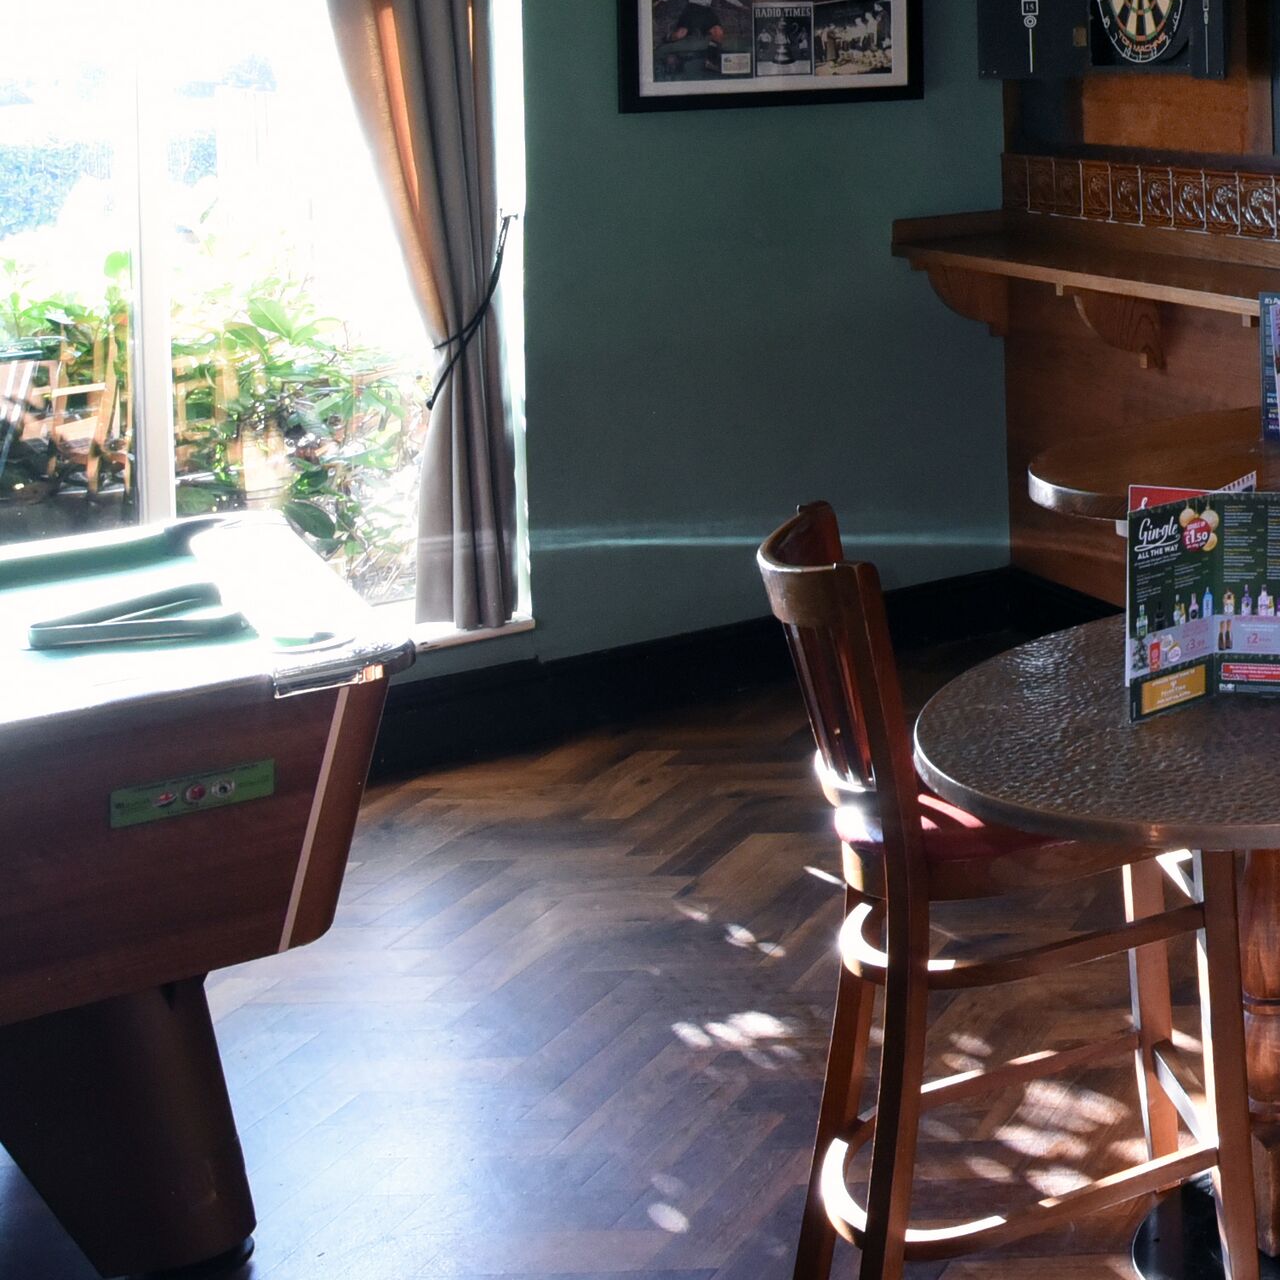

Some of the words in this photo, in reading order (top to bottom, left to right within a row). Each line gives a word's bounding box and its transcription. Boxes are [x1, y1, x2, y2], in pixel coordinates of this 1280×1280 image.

[755, 7, 782, 18] RADIO
[783, 7, 811, 17] TIMES
[1025, 3, 1035, 11] 15
[1185, 529, 1208, 545] £1.50
[1137, 551, 1149, 560] ALL
[1150, 548, 1163, 557] THE
[1164, 544, 1179, 553] WAY
